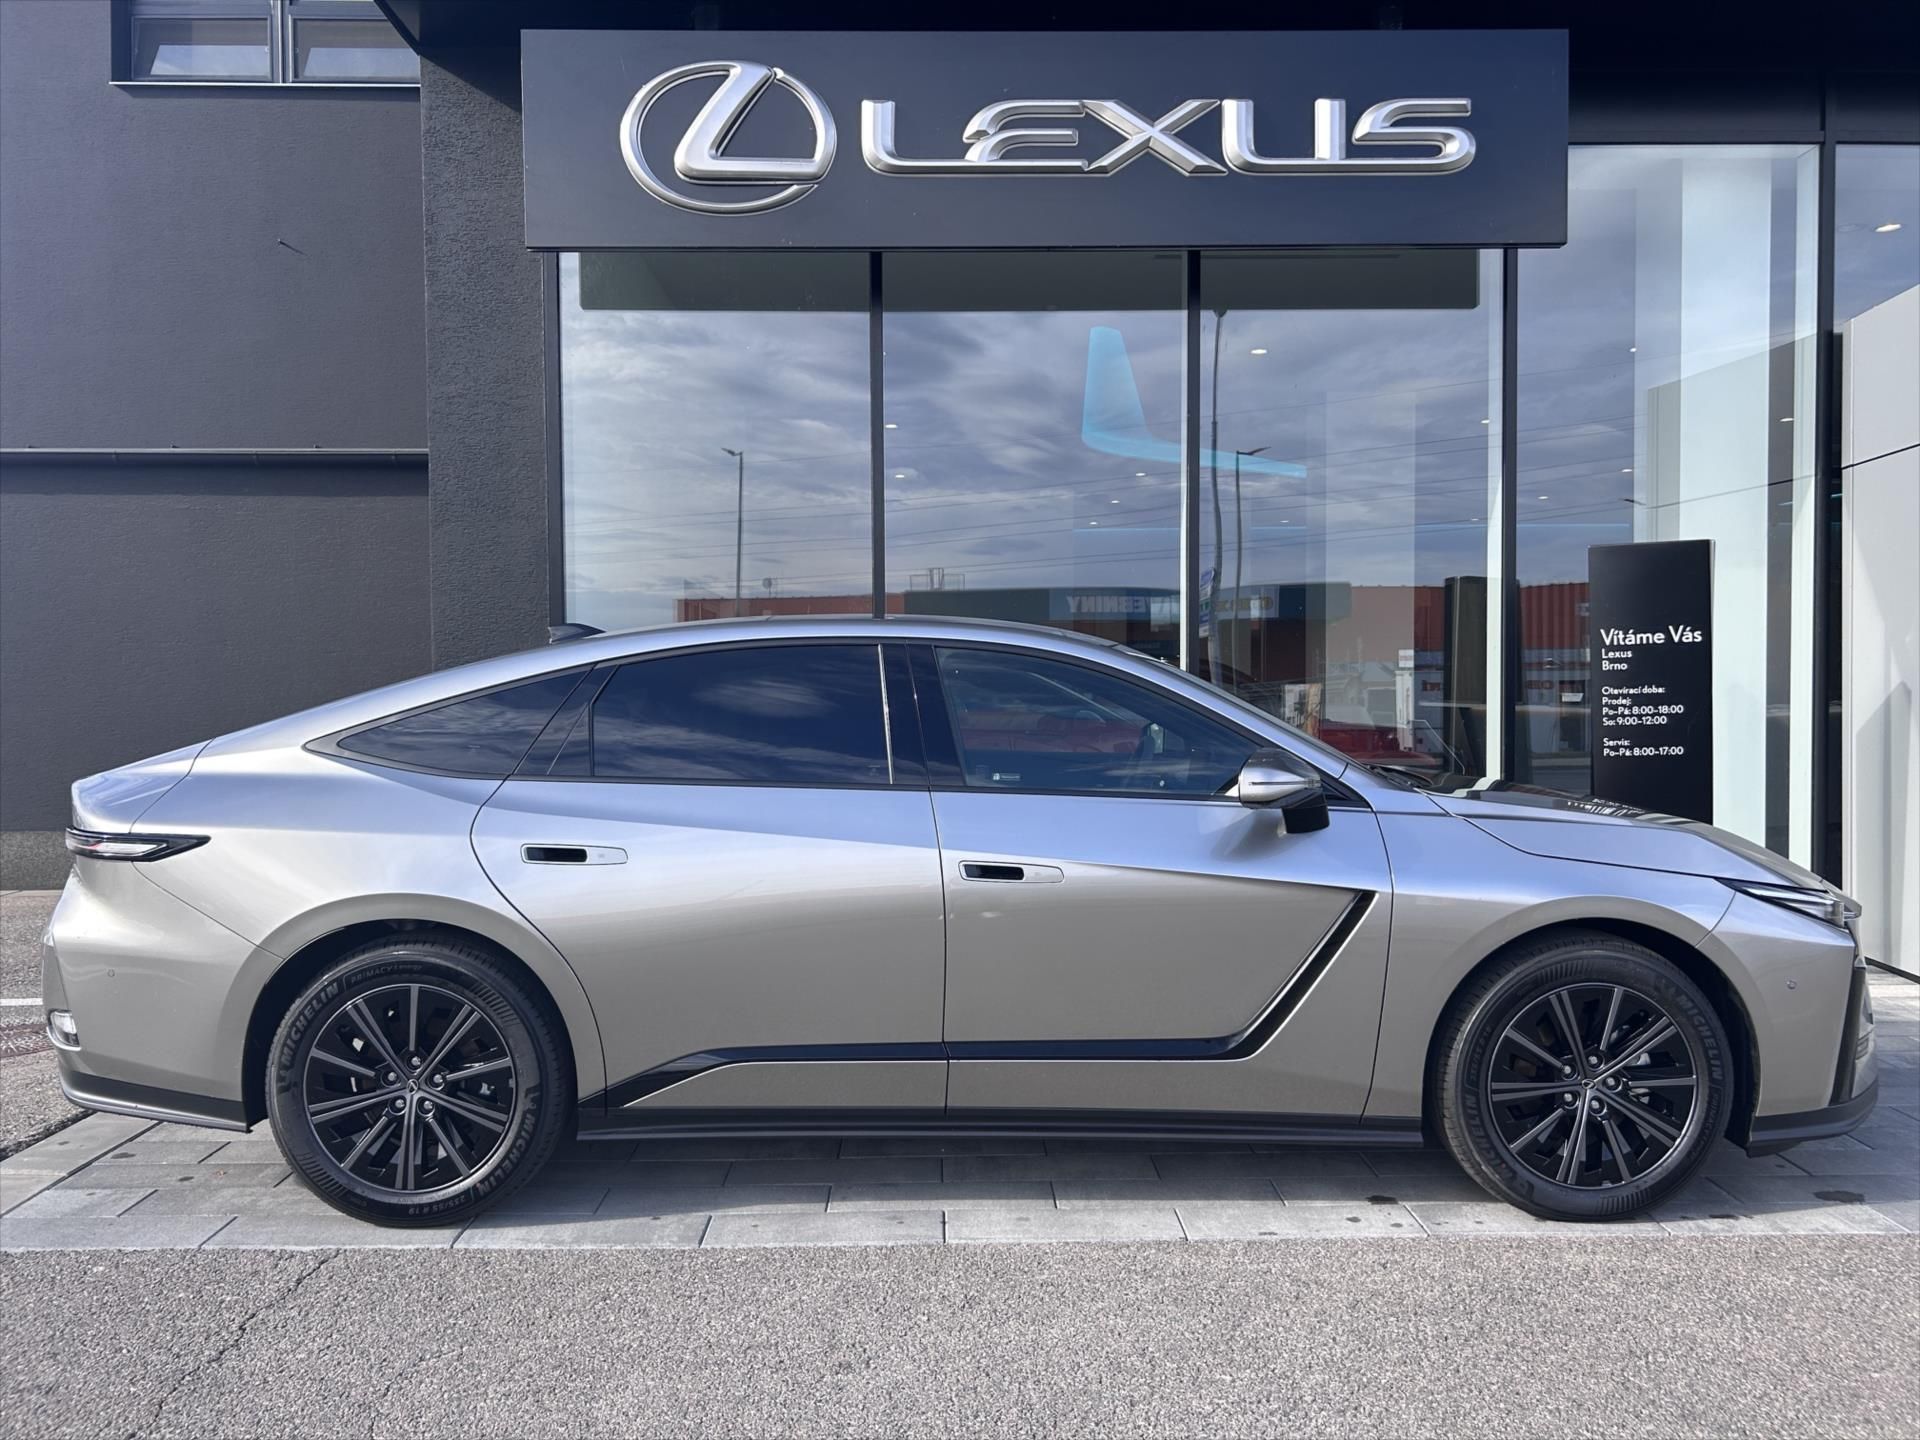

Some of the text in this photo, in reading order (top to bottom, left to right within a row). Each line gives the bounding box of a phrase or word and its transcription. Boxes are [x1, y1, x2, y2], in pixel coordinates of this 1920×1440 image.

[861, 97, 1478, 177] LEXUS
[1600, 625, 1703, 646] Vítáme Vás
[1601, 648, 1633, 659] Lexus
[1602, 660, 1628, 671] Brno
[1602, 684, 1666, 695] Otevírací doba:
[1602, 696, 1632, 706] Prodej:
[1603, 738, 1631, 747] Servis:
[281, 981, 340, 1066] MICHELIN
[1677, 993, 1722, 1078] MICHELIN
[476, 1114, 536, 1195] MICHELIN
